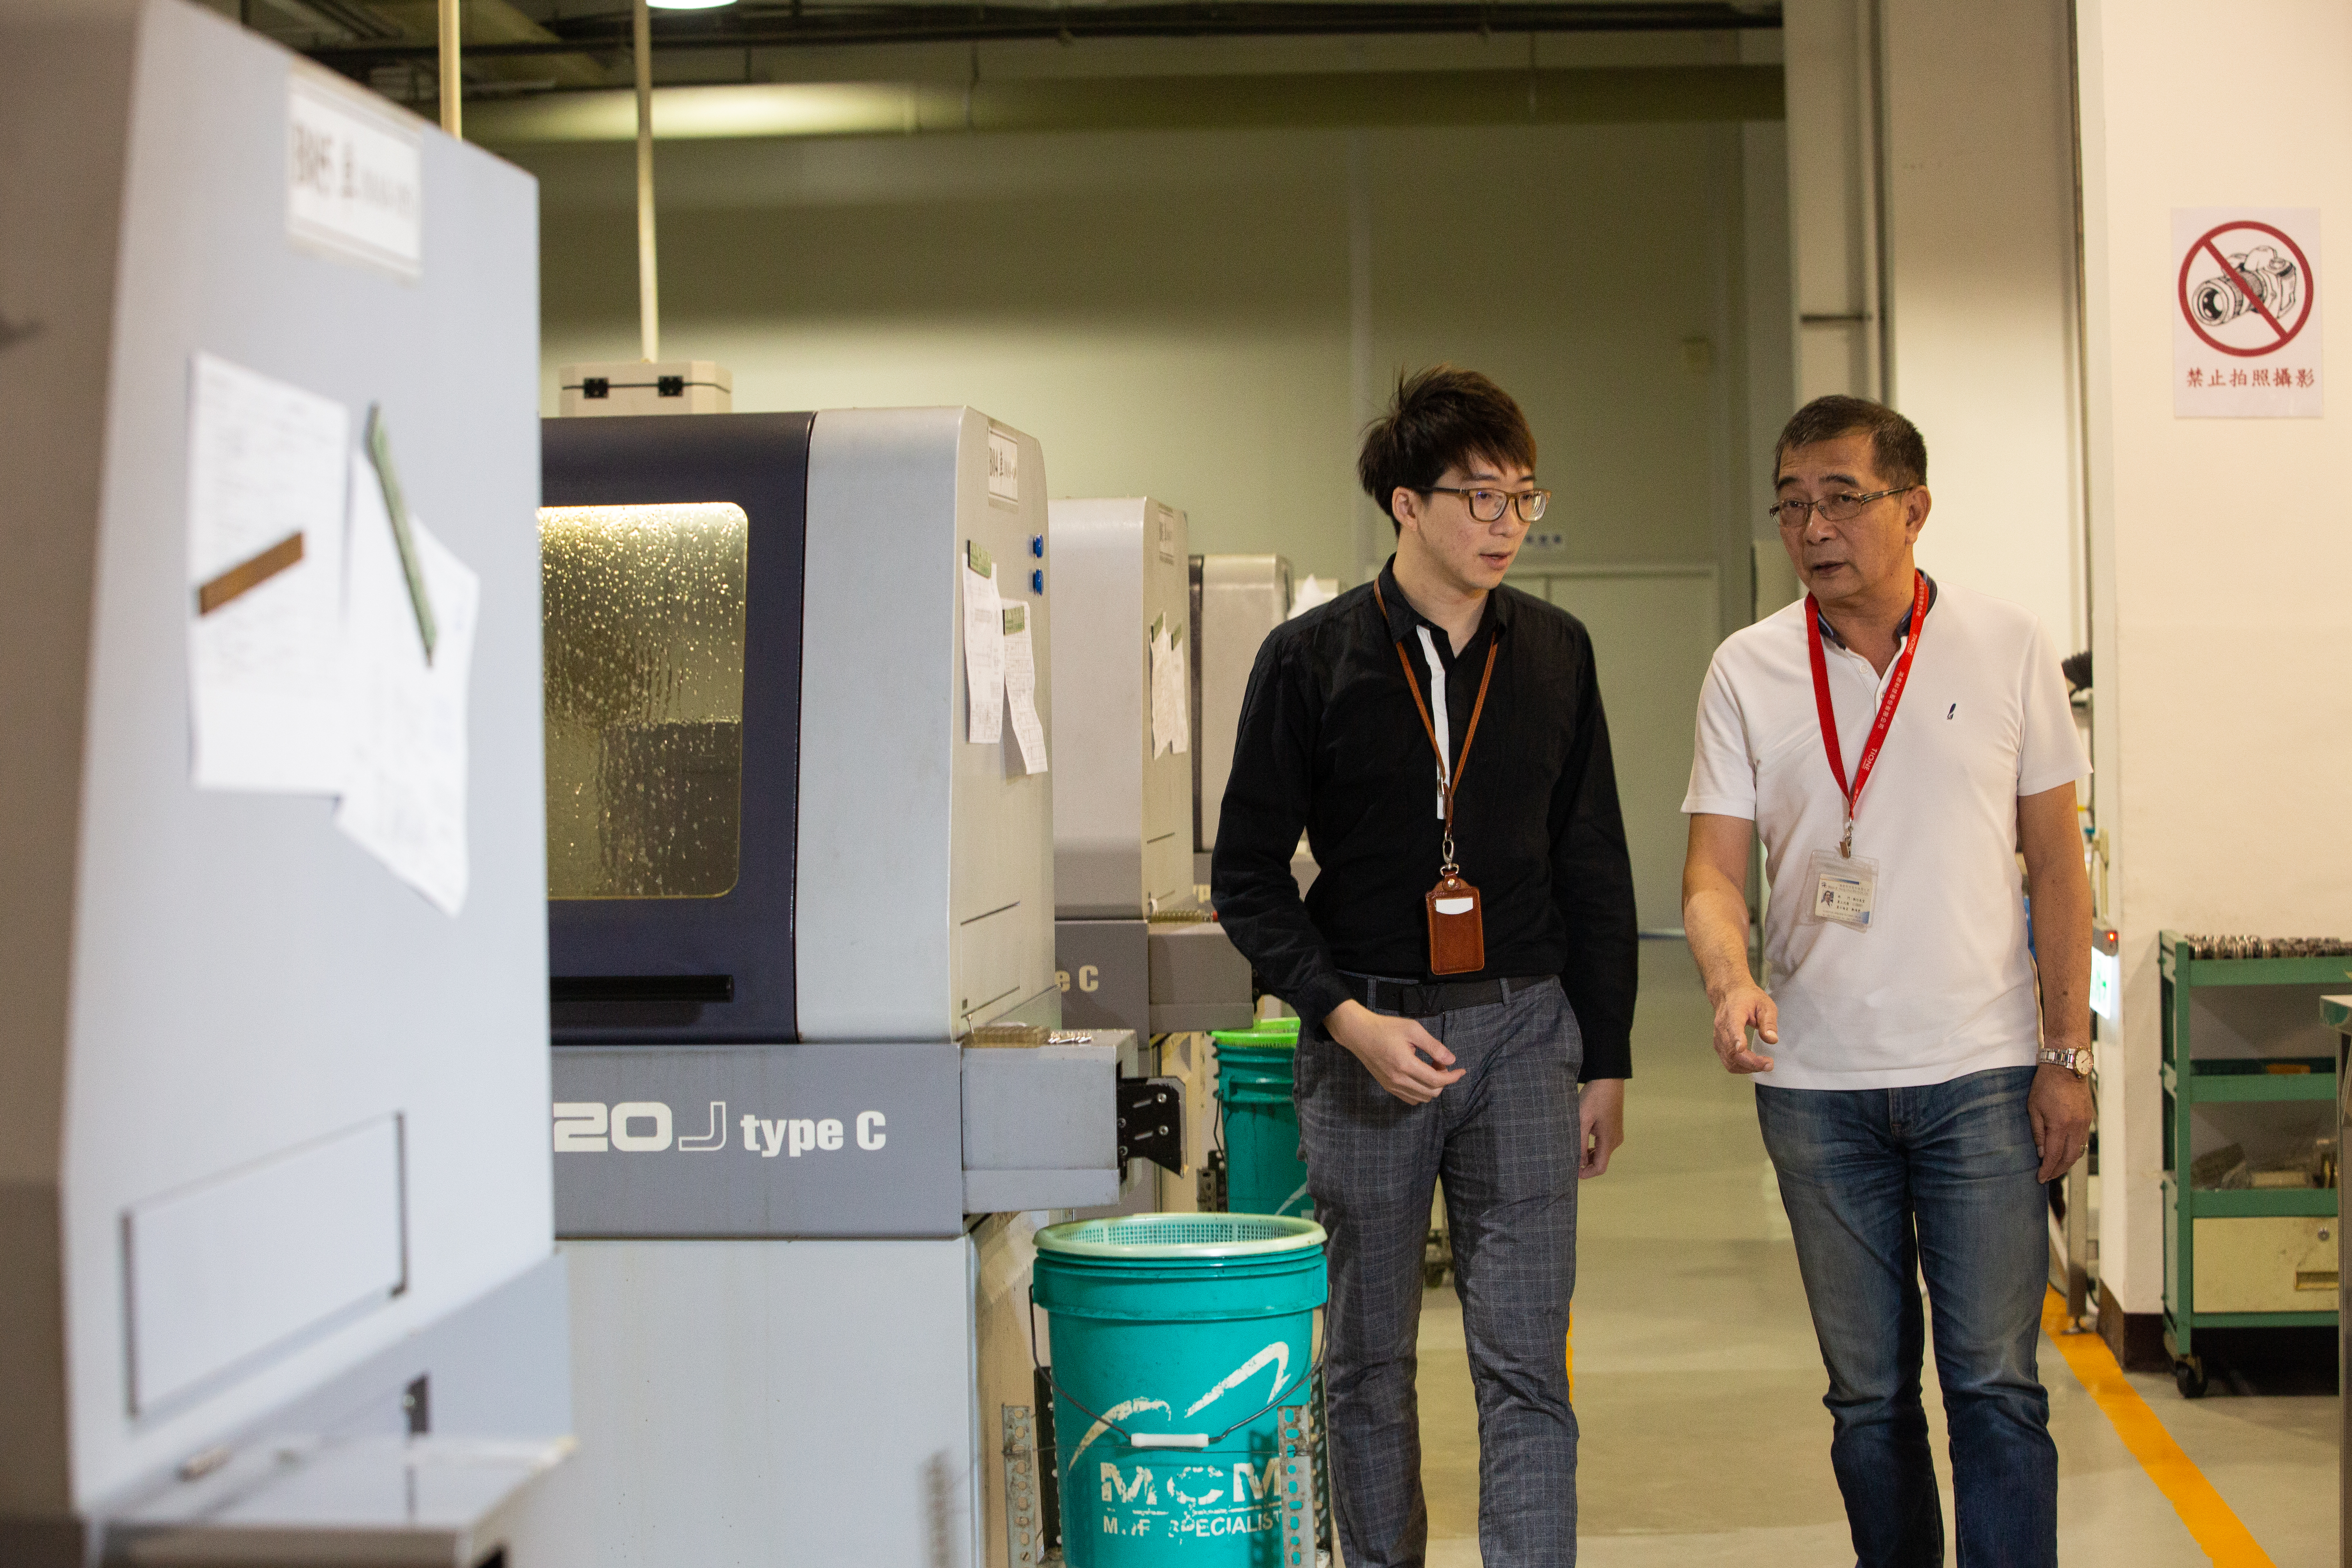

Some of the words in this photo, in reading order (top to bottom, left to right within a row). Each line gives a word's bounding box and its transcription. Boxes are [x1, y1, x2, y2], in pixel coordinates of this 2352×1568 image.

[2186, 367, 2314, 388] 禁止拍照攝影
[1864, 748, 1878, 771] TIONE
[1079, 965, 1099, 993] C
[740, 1114, 844, 1157] type
[856, 1111, 886, 1150] C
[1100, 1458, 1281, 1506] MCM
